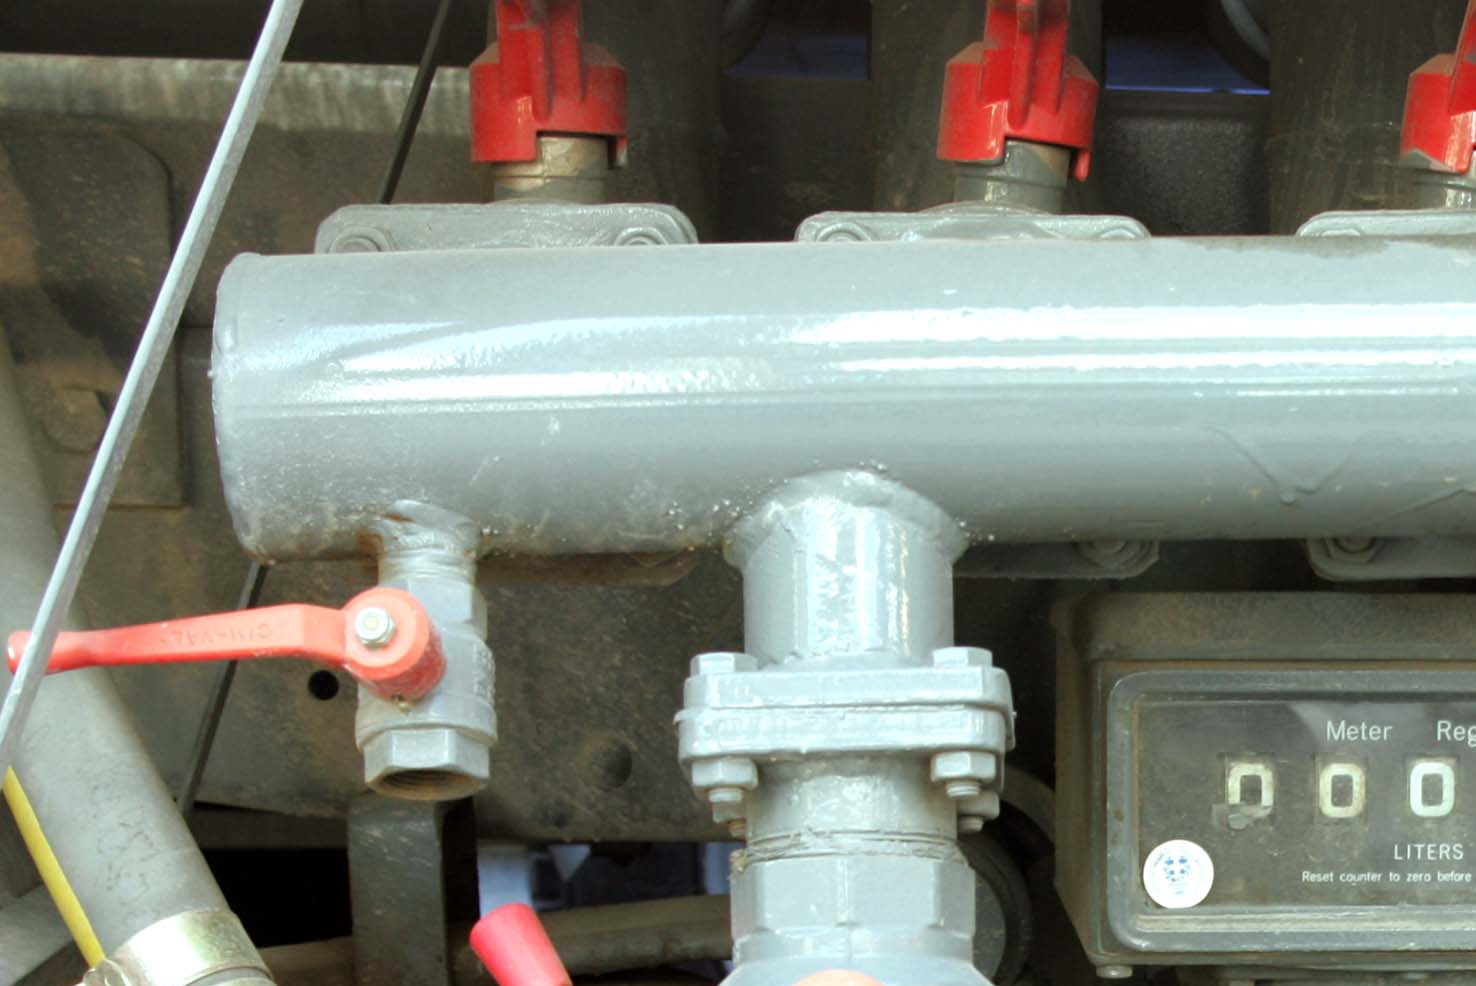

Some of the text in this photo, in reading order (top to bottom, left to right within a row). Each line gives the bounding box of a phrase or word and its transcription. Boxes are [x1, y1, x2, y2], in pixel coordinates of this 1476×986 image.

[1326, 719, 1393, 741] Meter
[1320, 762, 1366, 818] 0
[1410, 761, 1455, 817] 0
[1393, 843, 1465, 861] LITERS
[1301, 870, 1334, 883] Reset
[1339, 871, 1382, 883] counter
[1389, 871, 1400, 883] to
[1406, 873, 1431, 883] zero
[1437, 870, 1472, 883] before
